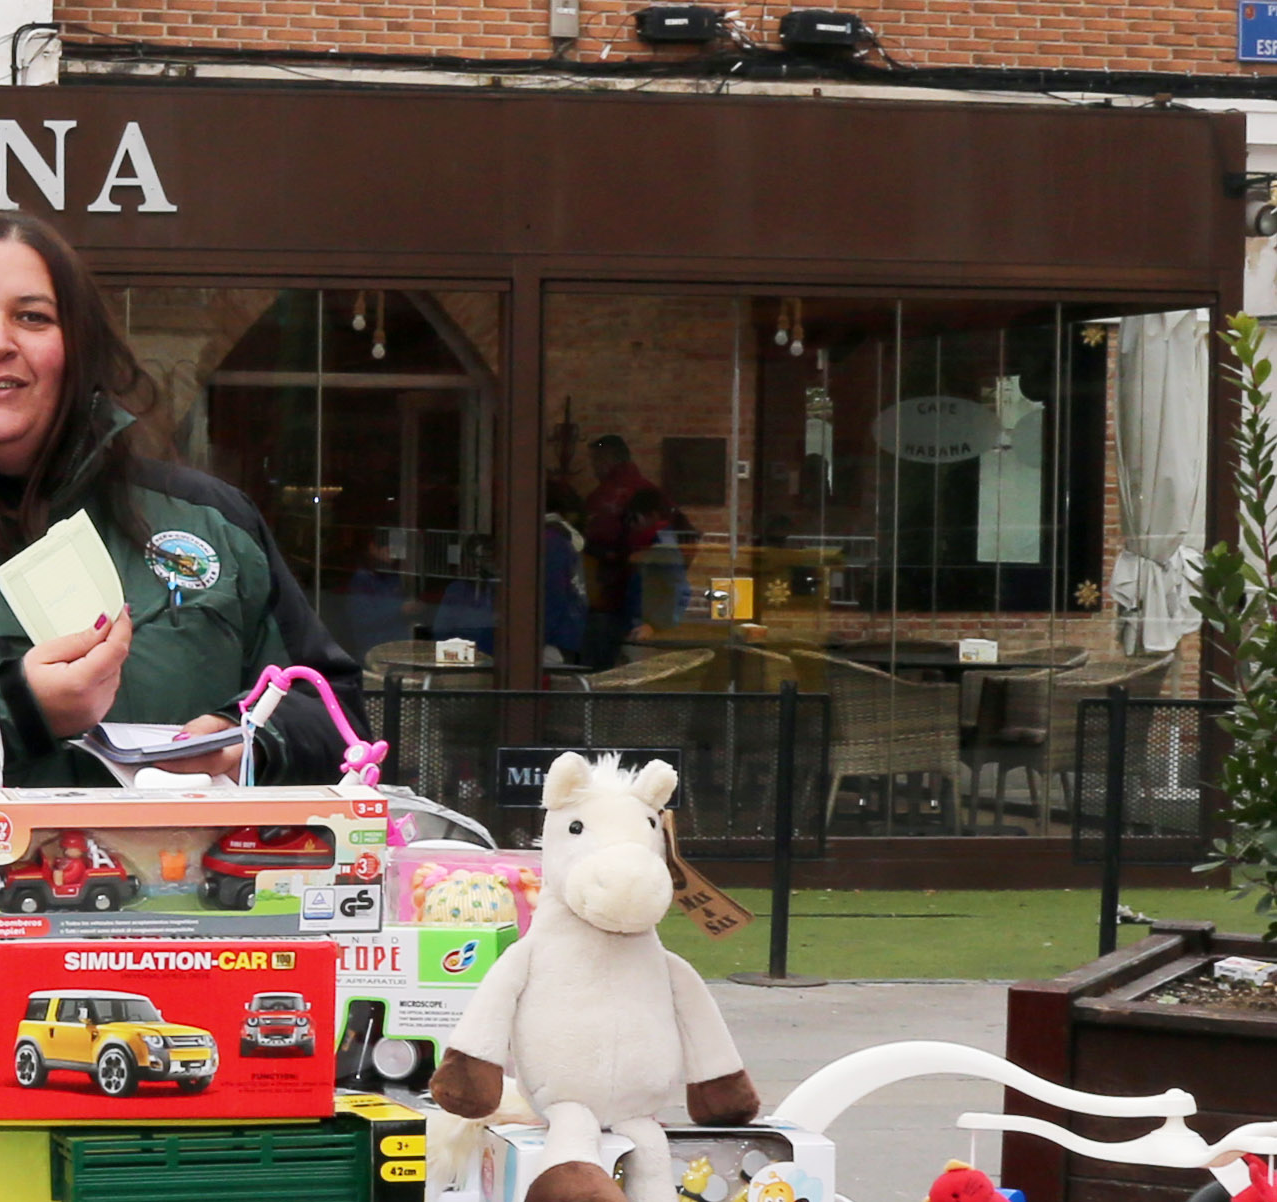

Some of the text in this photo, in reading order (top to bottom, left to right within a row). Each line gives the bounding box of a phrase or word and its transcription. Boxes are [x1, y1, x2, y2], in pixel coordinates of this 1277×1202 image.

[358, 803, 383, 813] 3-8
[64, 951, 267, 971] SIMULATION-CAR
[399, 1000, 443, 1009] MICROSCOPE
[396, 1141, 410, 1152] 3+
[390, 1167, 417, 1178] 42cm
